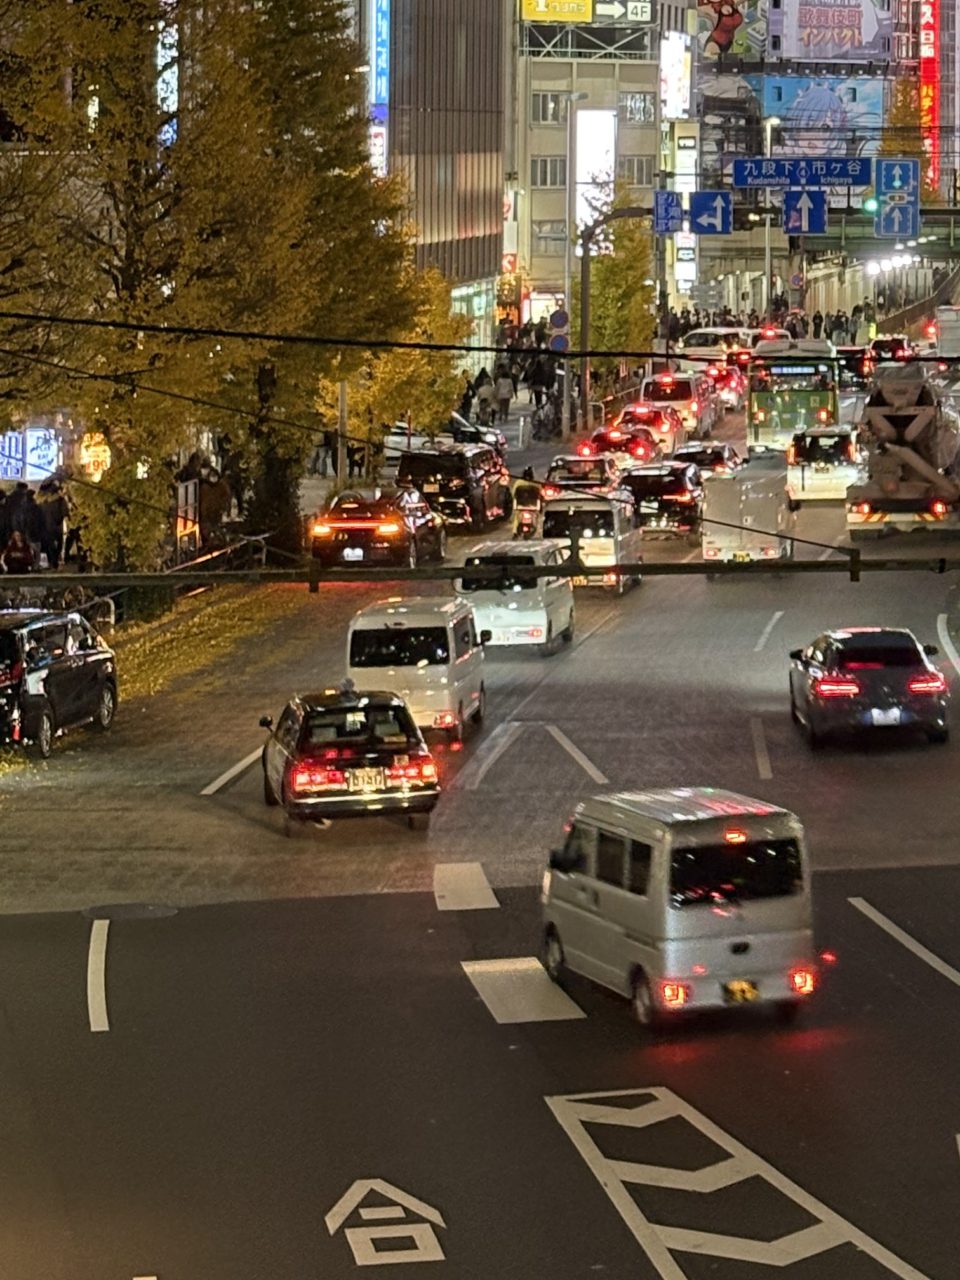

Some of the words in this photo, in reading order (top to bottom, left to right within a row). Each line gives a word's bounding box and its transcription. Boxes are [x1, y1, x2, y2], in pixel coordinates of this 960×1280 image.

[630, 2, 648, 18] 4F
[799, 8, 864, 28] 歌舞伎町
[799, 27, 864, 48] インパクト
[743, 160, 794, 176] 九段下
[747, 176, 791, 185] Kudanshita
[820, 176, 853, 185] Ichigaya
